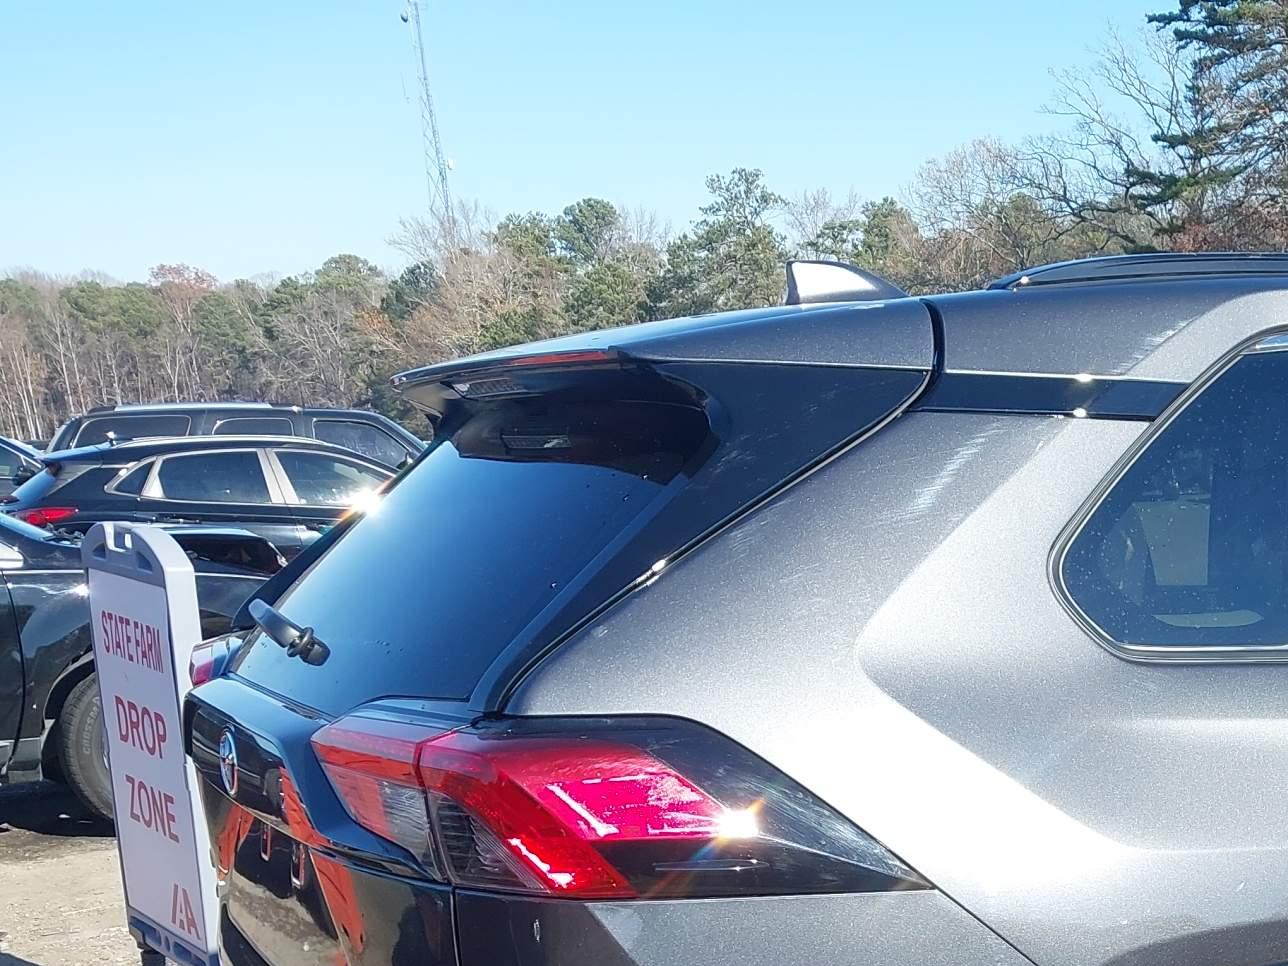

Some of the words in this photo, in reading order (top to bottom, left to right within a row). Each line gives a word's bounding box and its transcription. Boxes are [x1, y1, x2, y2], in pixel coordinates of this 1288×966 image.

[101, 610, 134, 662] STATE
[134, 620, 164, 673] FARM
[114, 694, 168, 760] DROP
[125, 774, 181, 844] ZONE
